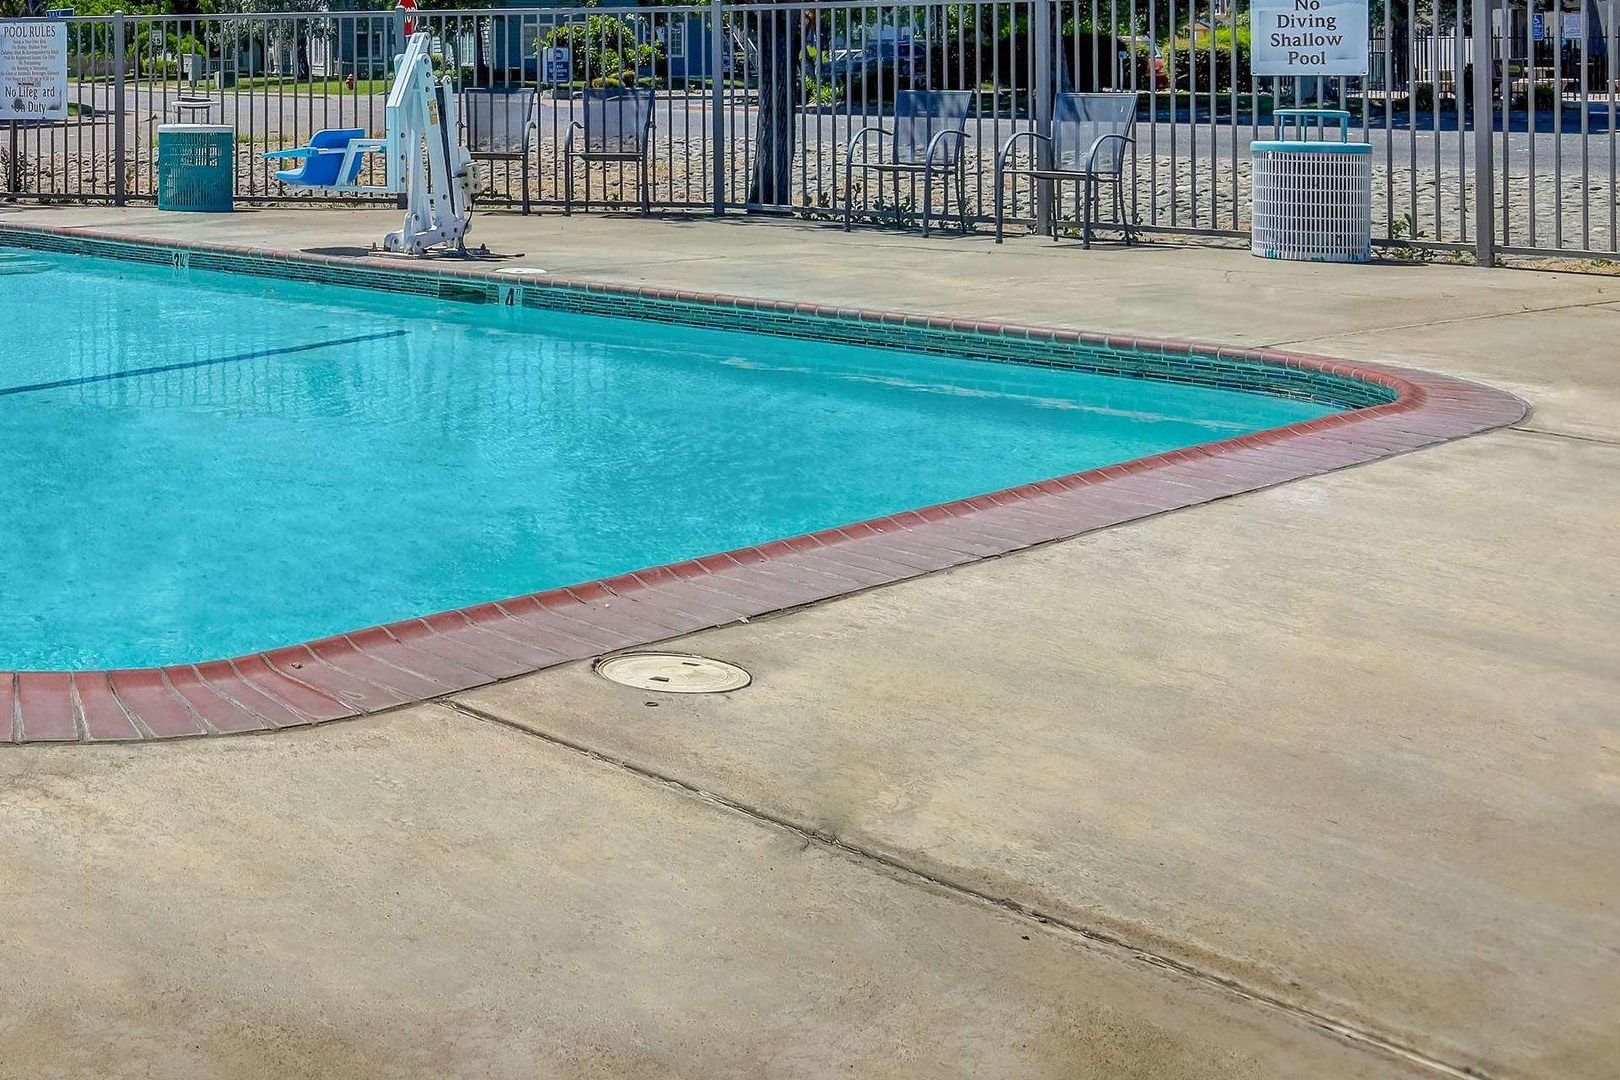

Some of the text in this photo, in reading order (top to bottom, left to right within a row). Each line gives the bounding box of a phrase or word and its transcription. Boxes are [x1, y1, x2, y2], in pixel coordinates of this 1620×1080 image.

[1276, 13, 1337, 31] Diving
[4, 25, 56, 38] POOL RULES
[1270, 32, 1343, 47] Shallow
[1287, 51, 1326, 65] Pool
[5, 86, 17, 98] No
[27, 101, 46, 115] Duty
